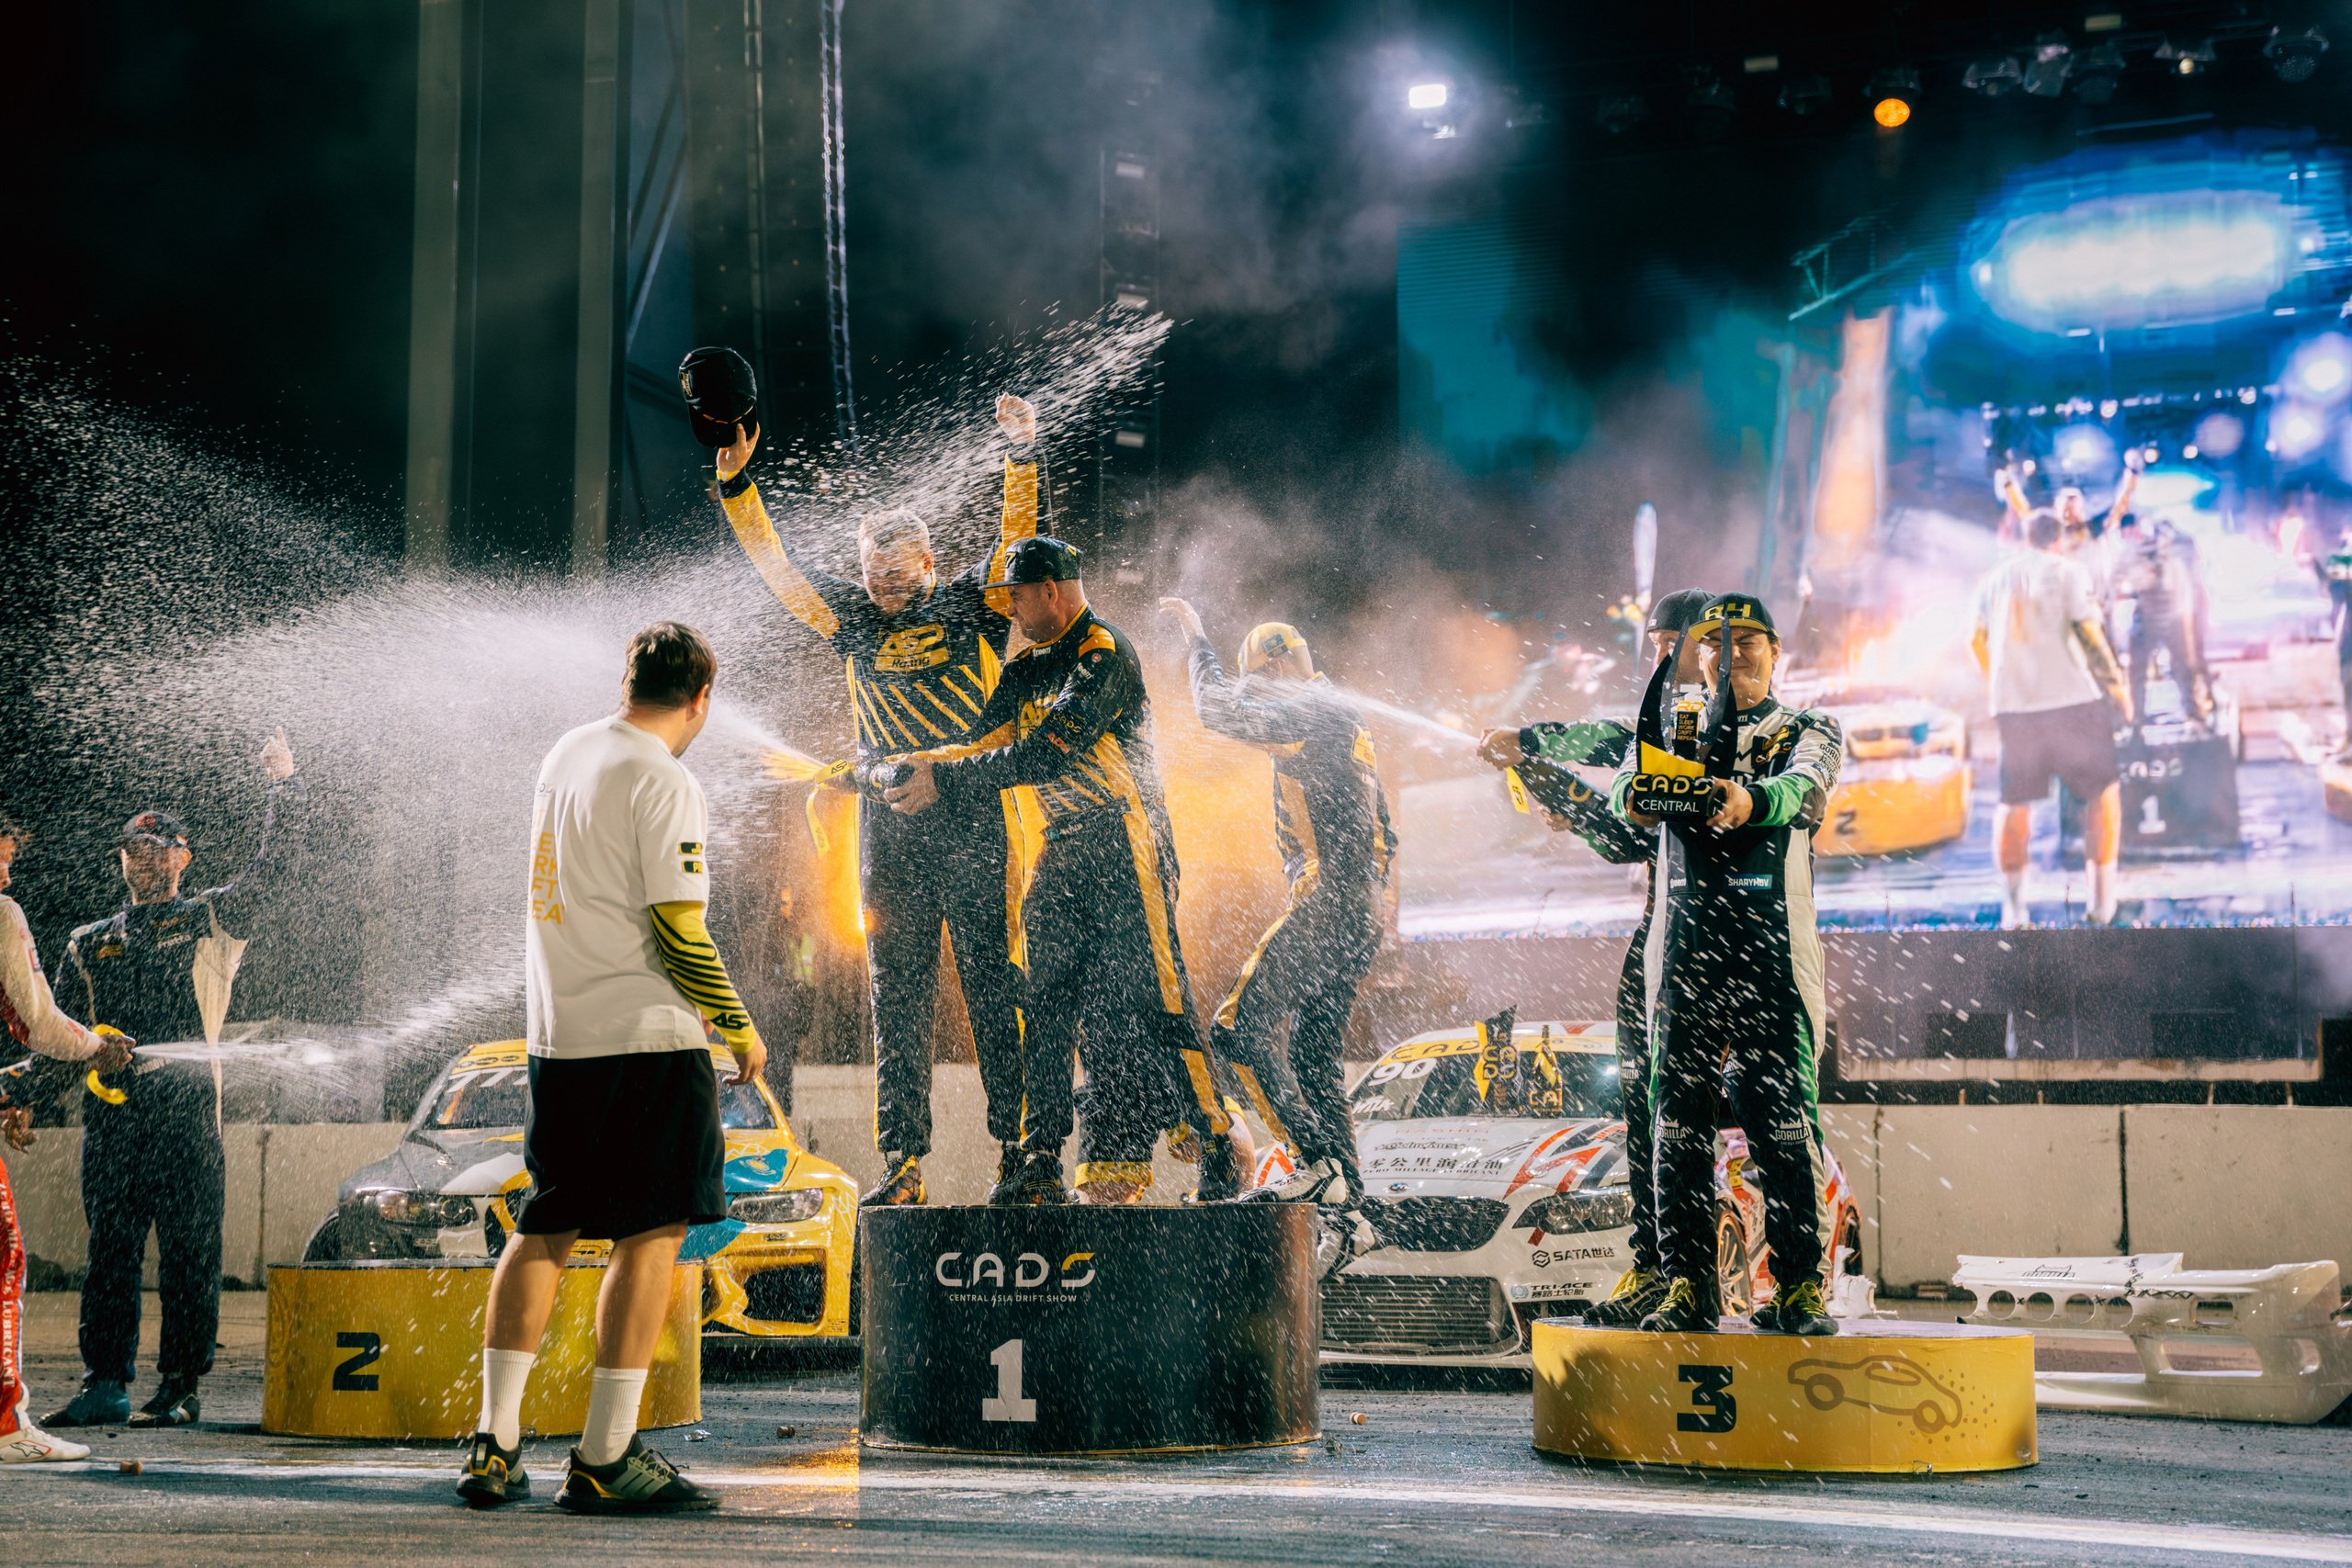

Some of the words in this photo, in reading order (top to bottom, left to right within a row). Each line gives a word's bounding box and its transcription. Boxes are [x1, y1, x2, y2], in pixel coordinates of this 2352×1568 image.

[891, 656, 930, 669] Raing
[1631, 774, 1711, 796] CADS
[1640, 798, 1700, 813] CENTRAL
[1368, 1057, 1438, 1087] 90
[1657, 1124, 1687, 1139] GORILLA
[1774, 1126, 1809, 1142] GORILLA
[935, 1252, 1097, 1288] CADS
[1530, 1281, 1595, 1292] TRI-ACE
[948, 1293, 989, 1303] CENTRAL
[990, 1293, 1013, 1303] ASIA
[1014, 1293, 1045, 1303] DRIFT
[1046, 1293, 1078, 1303] SHOW
[2, 1300, 16, 1388] LUBRICANT
[332, 1331, 381, 1392] 2
[981, 1338, 1037, 1422] 1
[1677, 1364, 1736, 1433] 3
